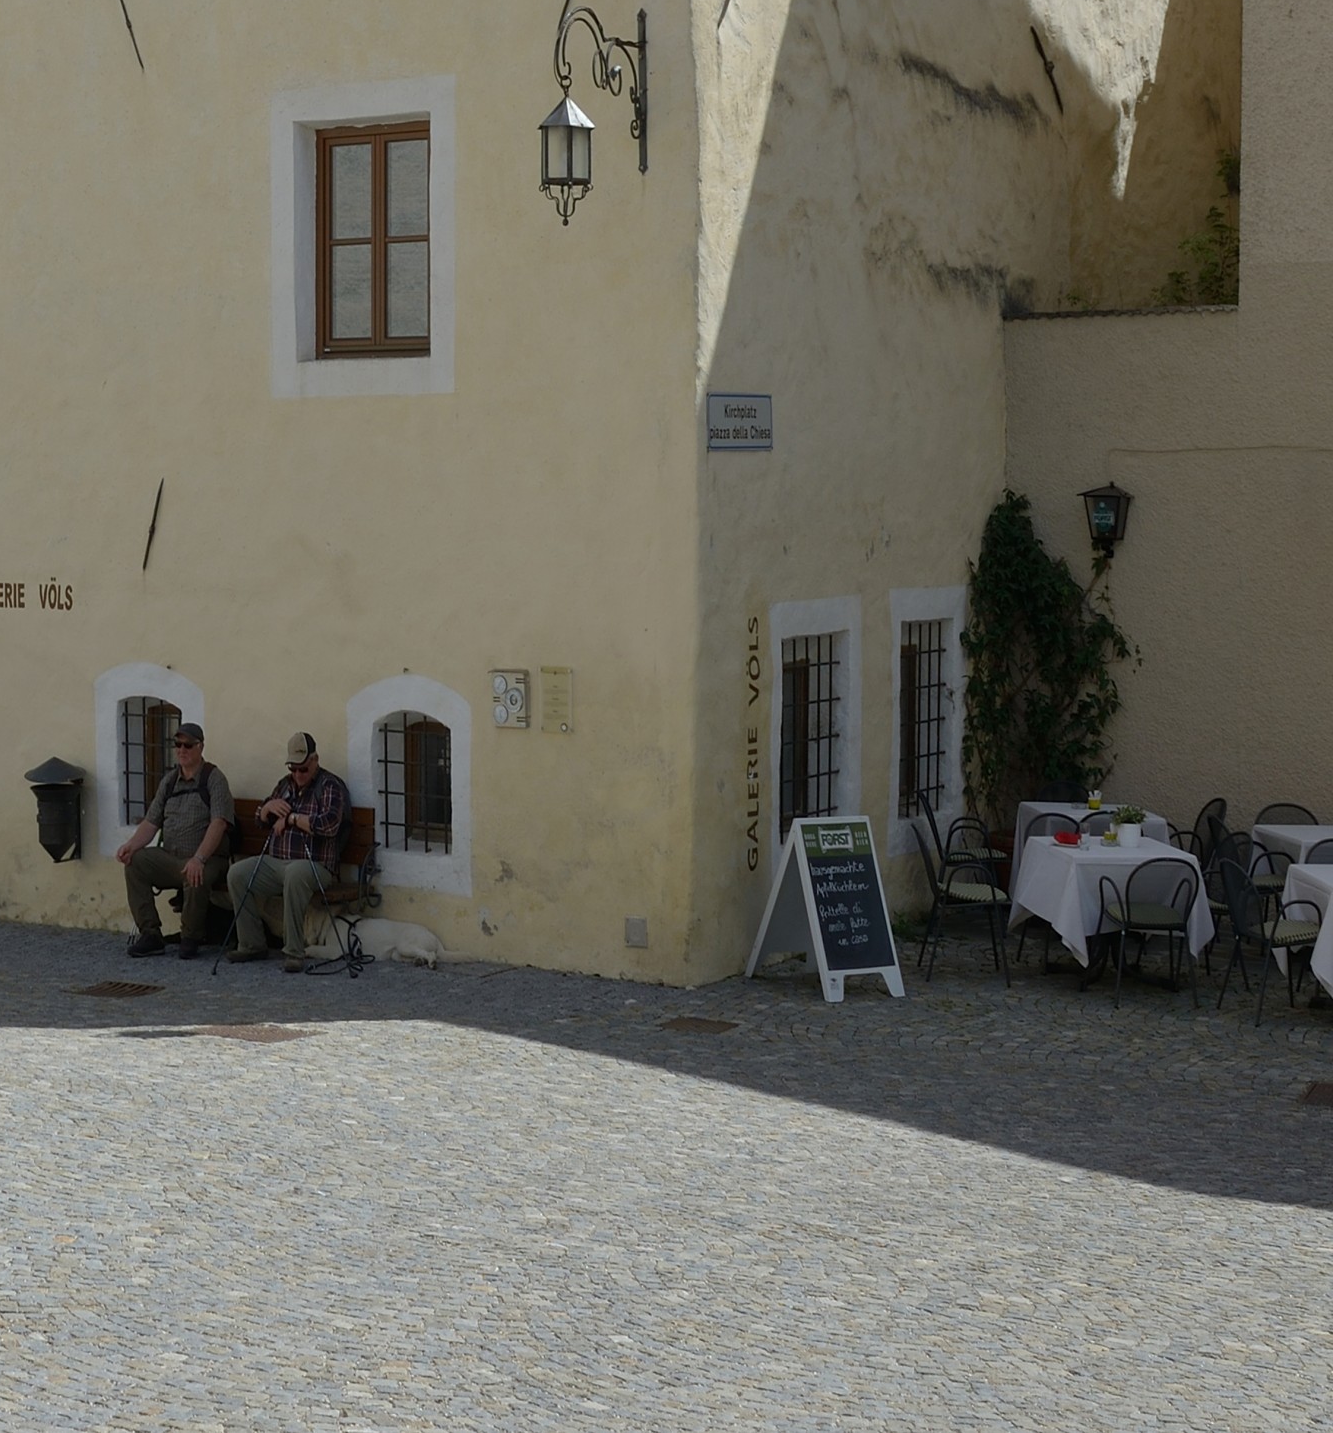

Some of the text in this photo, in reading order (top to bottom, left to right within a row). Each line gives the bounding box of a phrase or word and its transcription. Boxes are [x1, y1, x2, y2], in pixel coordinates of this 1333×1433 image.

[724, 404, 757, 421] Kirchplatz
[710, 425, 771, 440] piazza della Chiesa
[39, 577, 73, 611] VÖLS
[746, 615, 761, 872] GALERIE VÖLS
[821, 832, 850, 847] FORST
